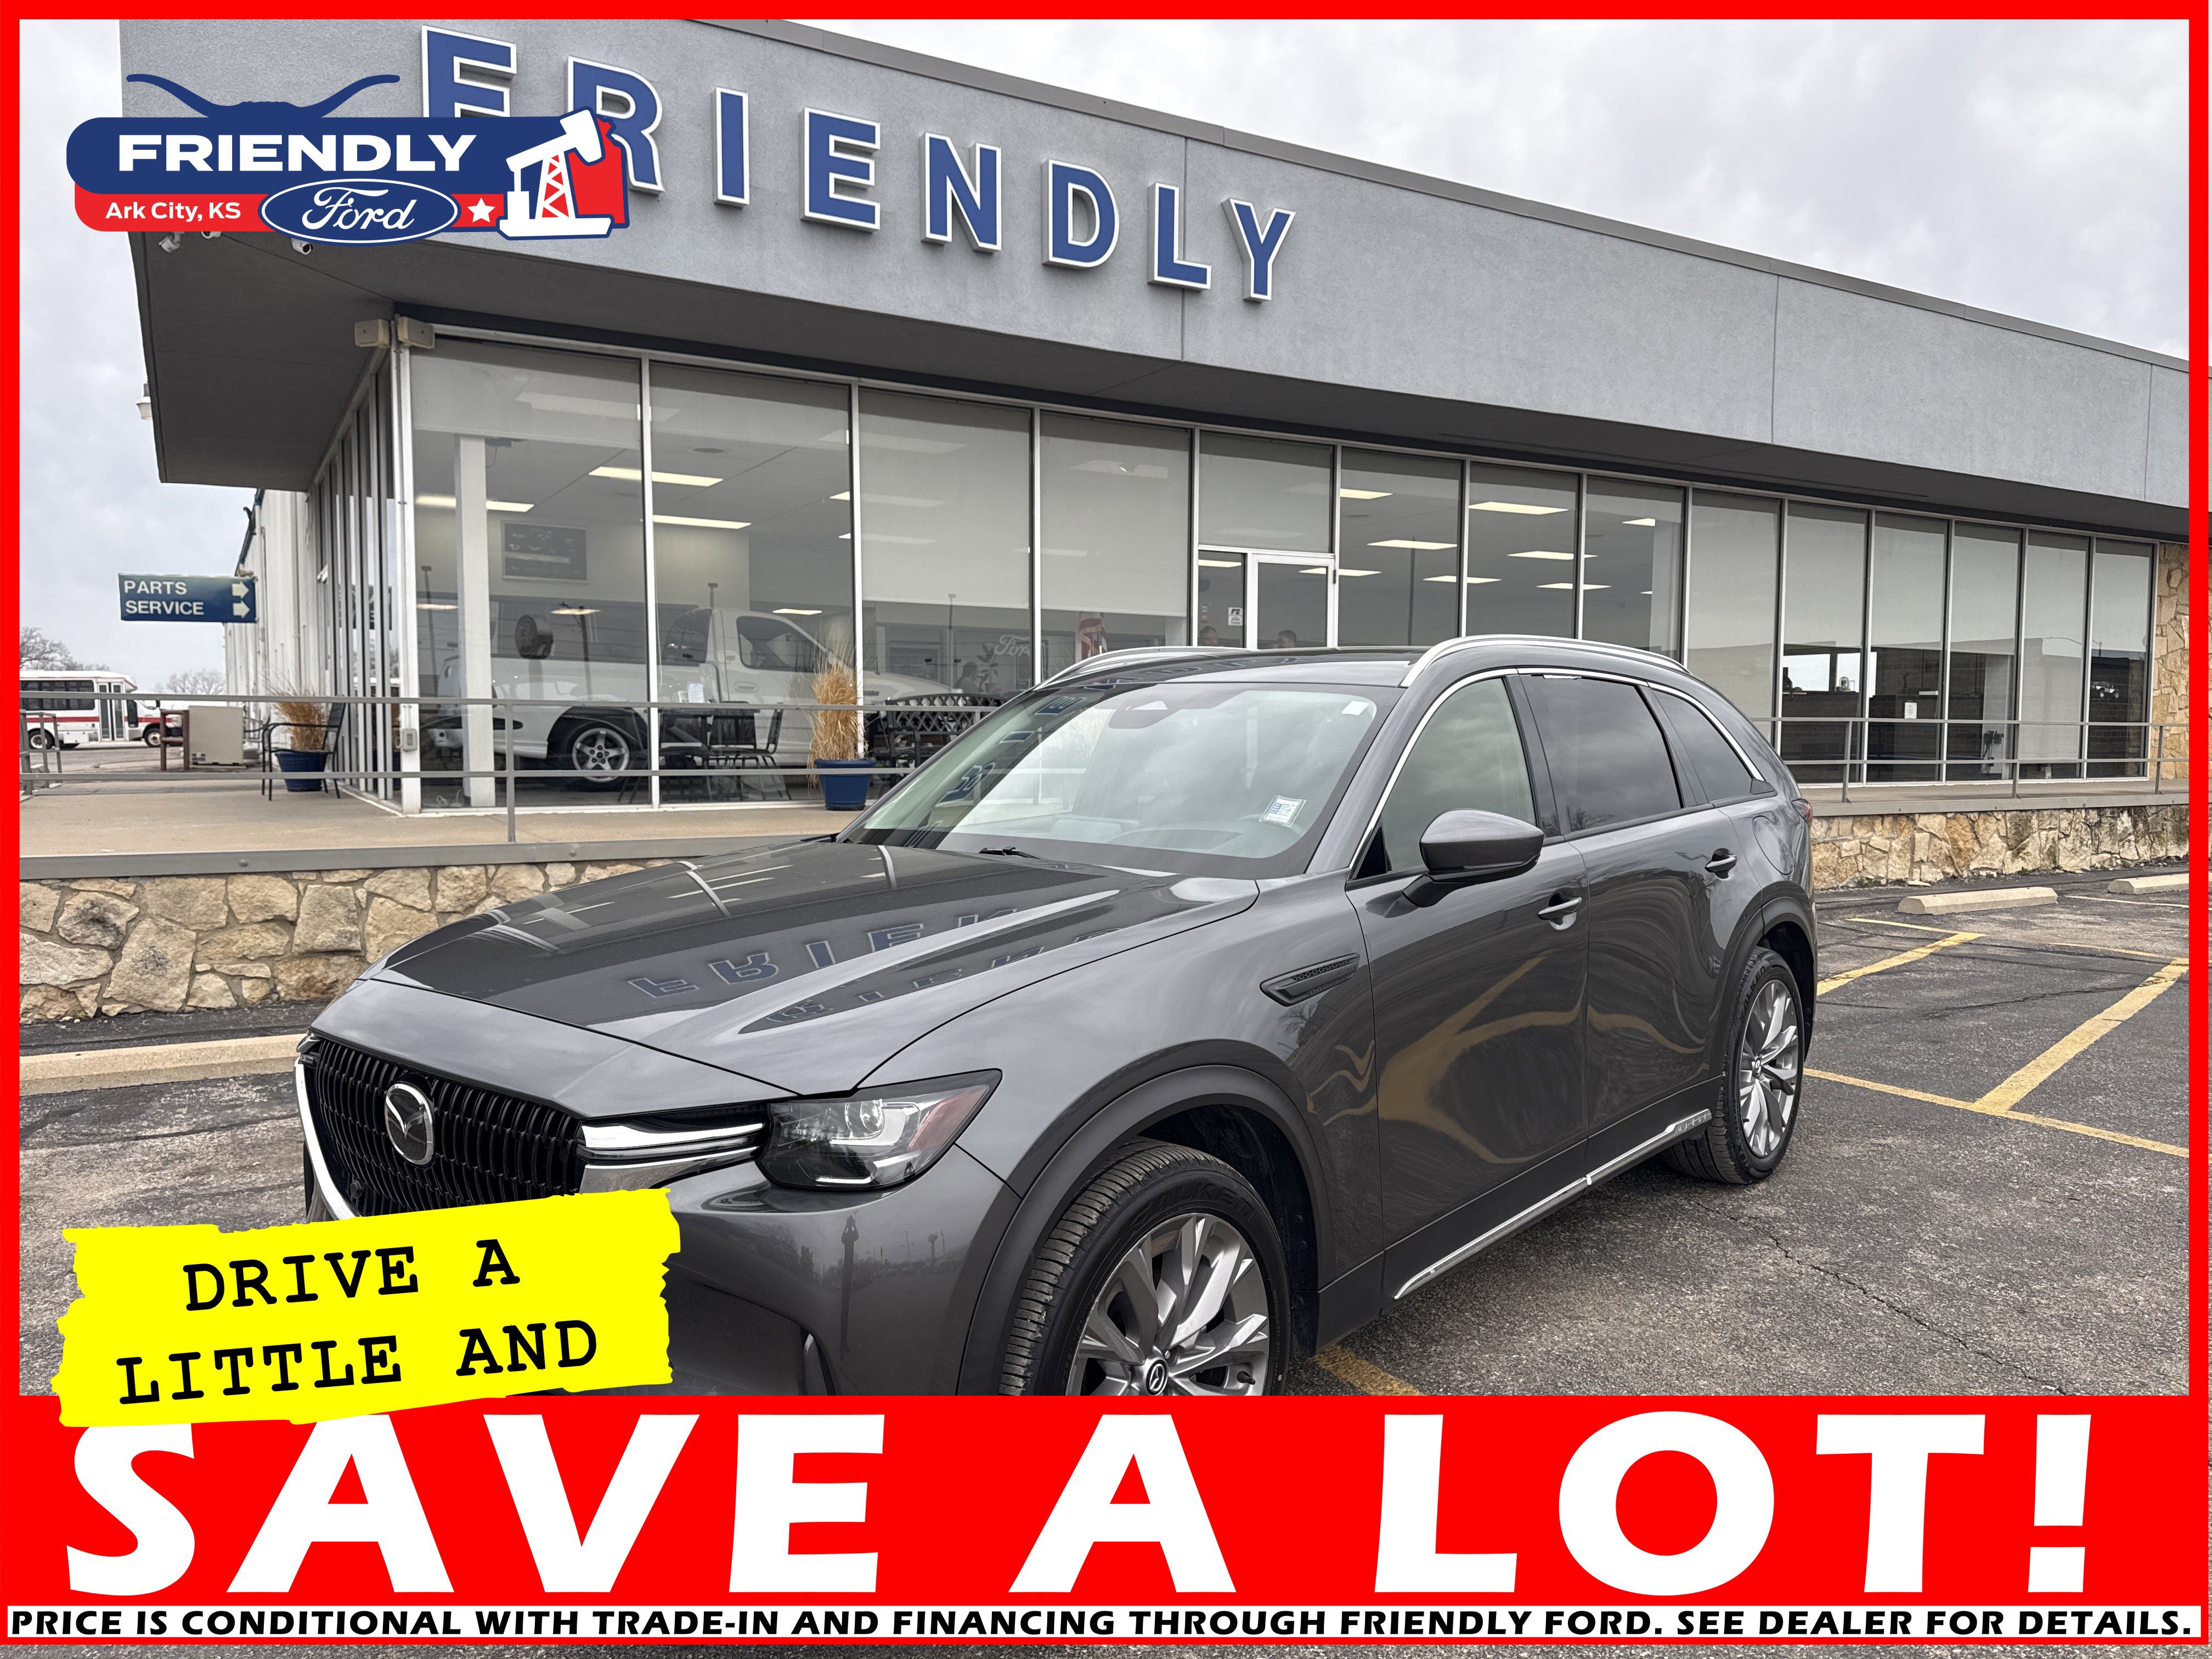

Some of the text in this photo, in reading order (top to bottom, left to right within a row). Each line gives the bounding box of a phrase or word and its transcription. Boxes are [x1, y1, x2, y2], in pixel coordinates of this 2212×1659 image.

[124, 580, 187, 595] PARTS
[125, 600, 205, 616] SERVICE
[994, 634, 1030, 657] For
